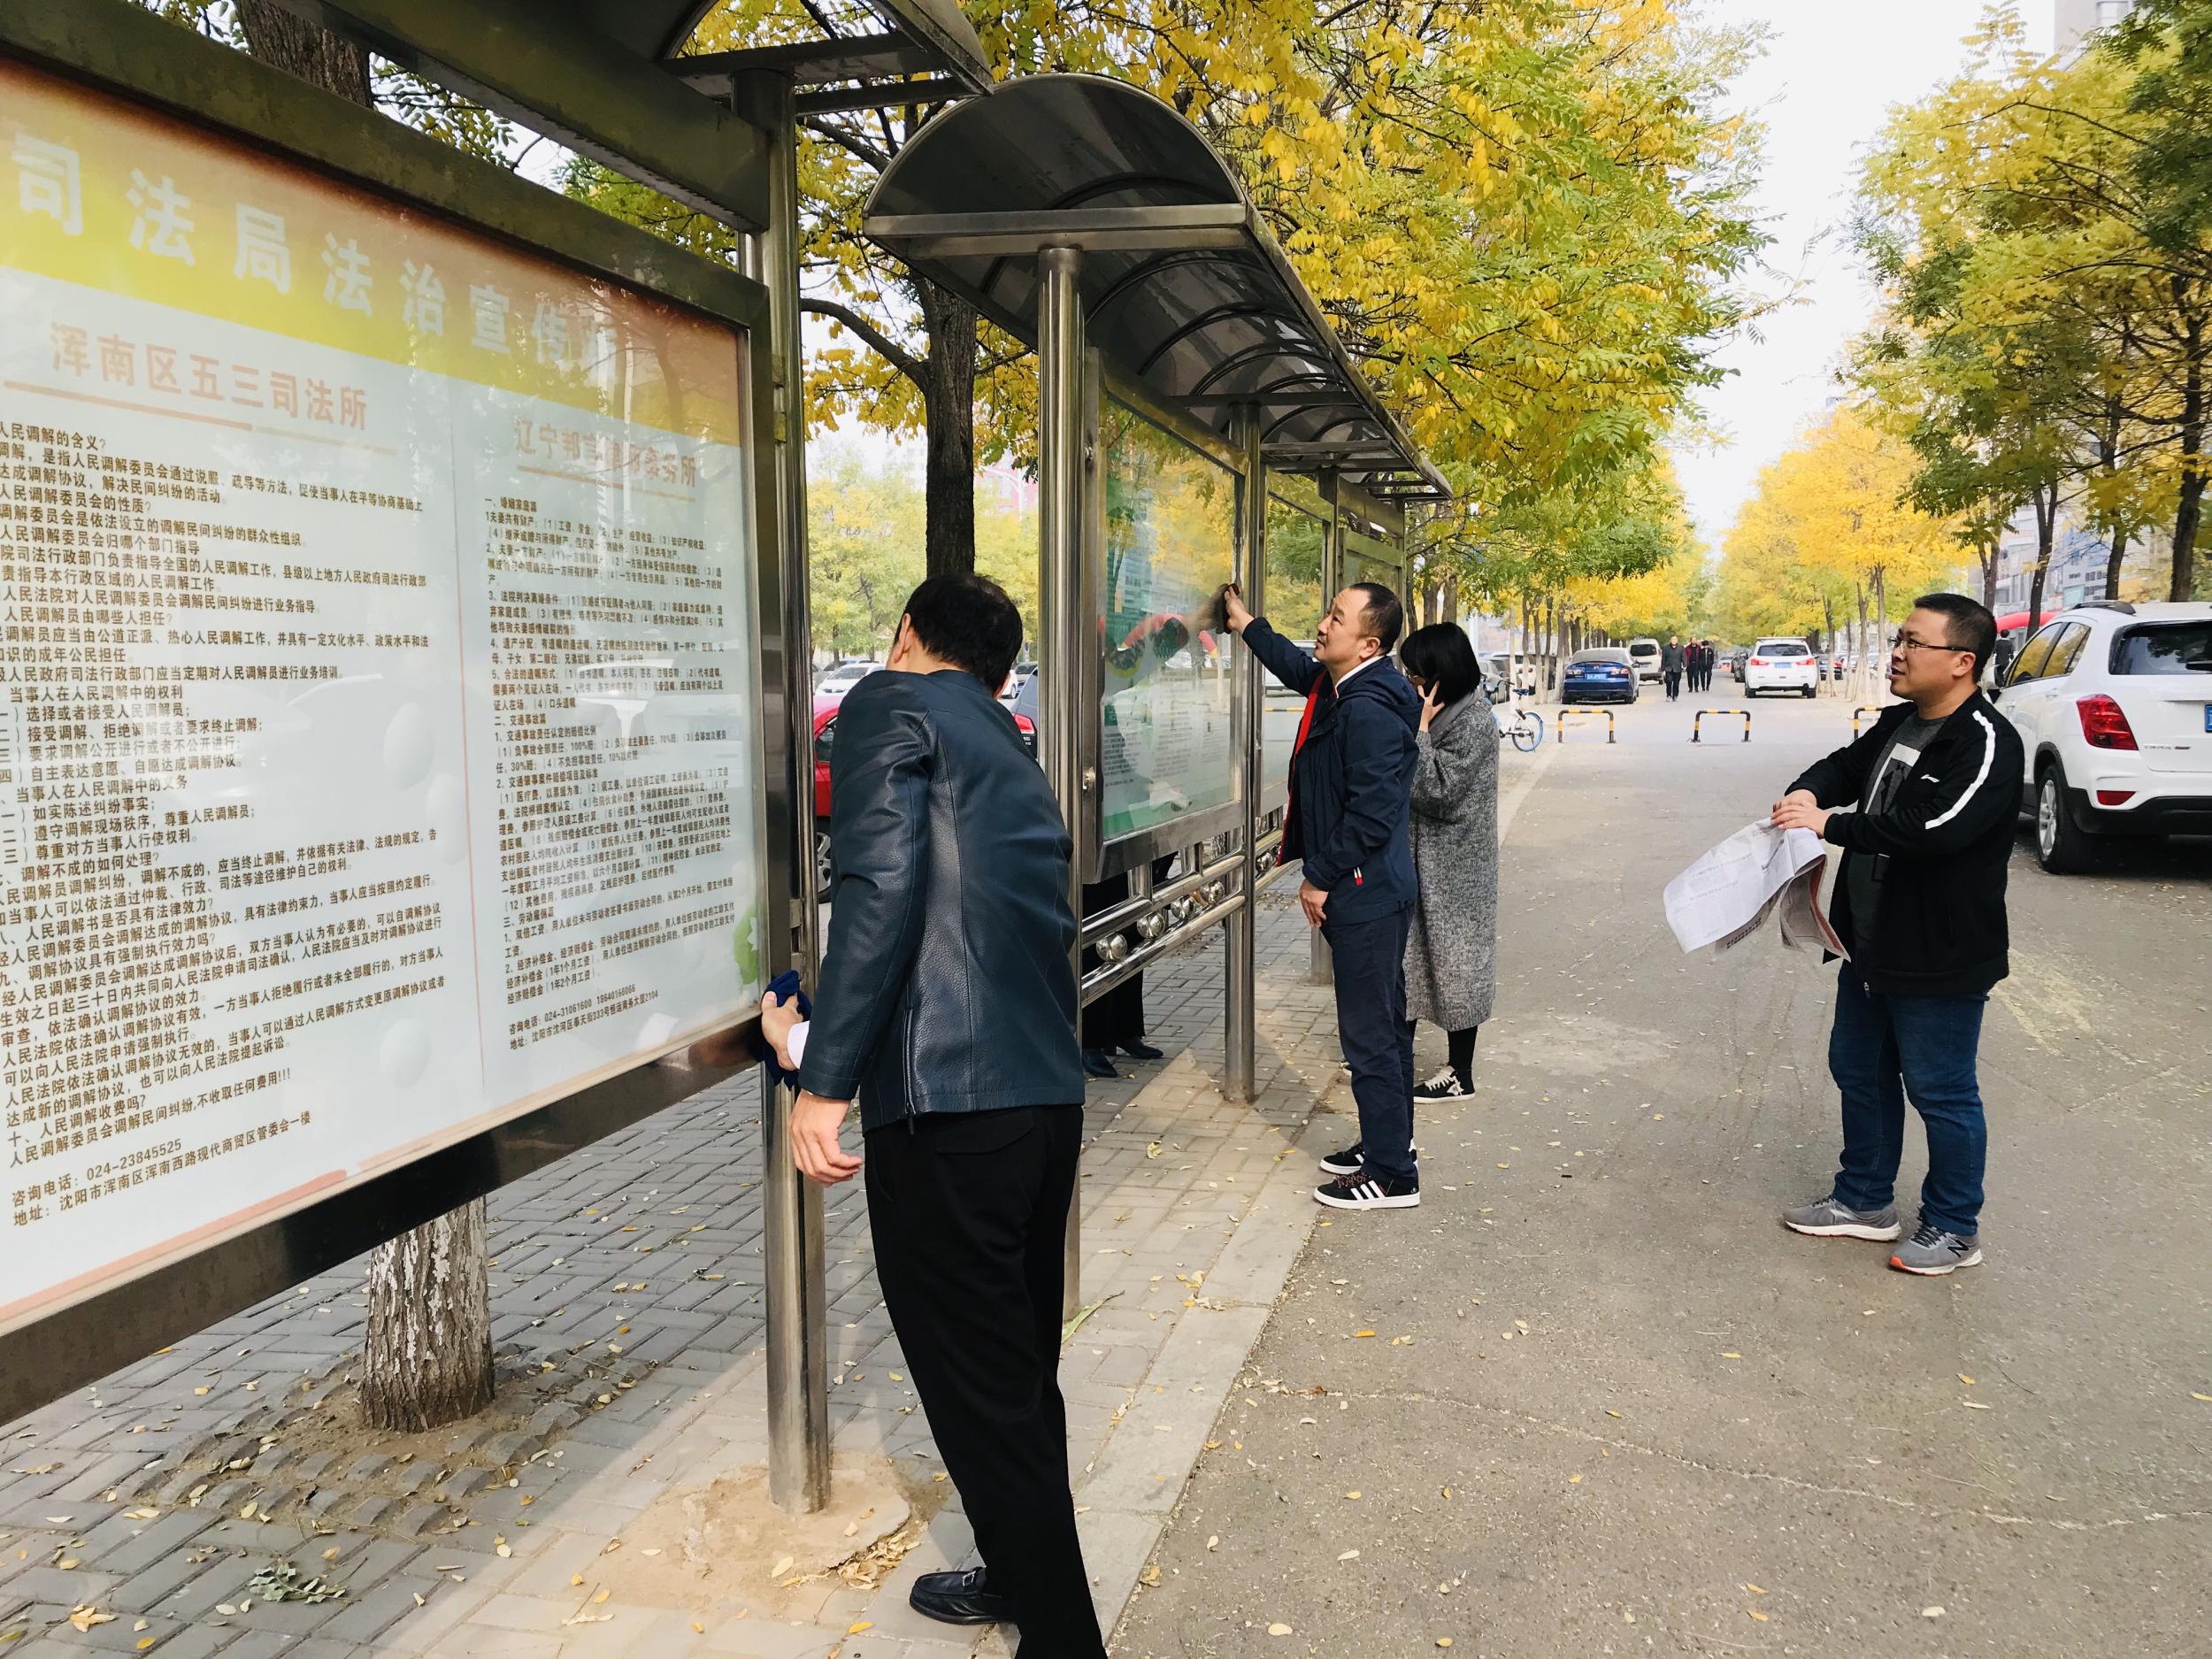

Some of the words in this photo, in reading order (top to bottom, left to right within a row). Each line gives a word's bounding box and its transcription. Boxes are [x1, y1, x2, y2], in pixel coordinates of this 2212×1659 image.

[50, 321, 369, 430] 浑南区五三司法所
[0, 483, 151, 513] 人民调解委员会的性质？
[1, 524, 200, 556] 人民调解委员会归哪个部门指导
[4, 605, 173, 626] 人民调解员由哪些人担任？
[0, 625, 428, 649] 调解员应当由公道正派、热心人民调解工作，并具有一定文化水平、政策水平和法
[11, 685, 182, 703] 当事人在人民调解中的权利
[0, 828, 436, 905] 民调解员调解纠纷，调解不成的，应当终止调解，并依据有关法律、法规的规定，告
[0, 851, 159, 885] 、调解不成的如何处理？
